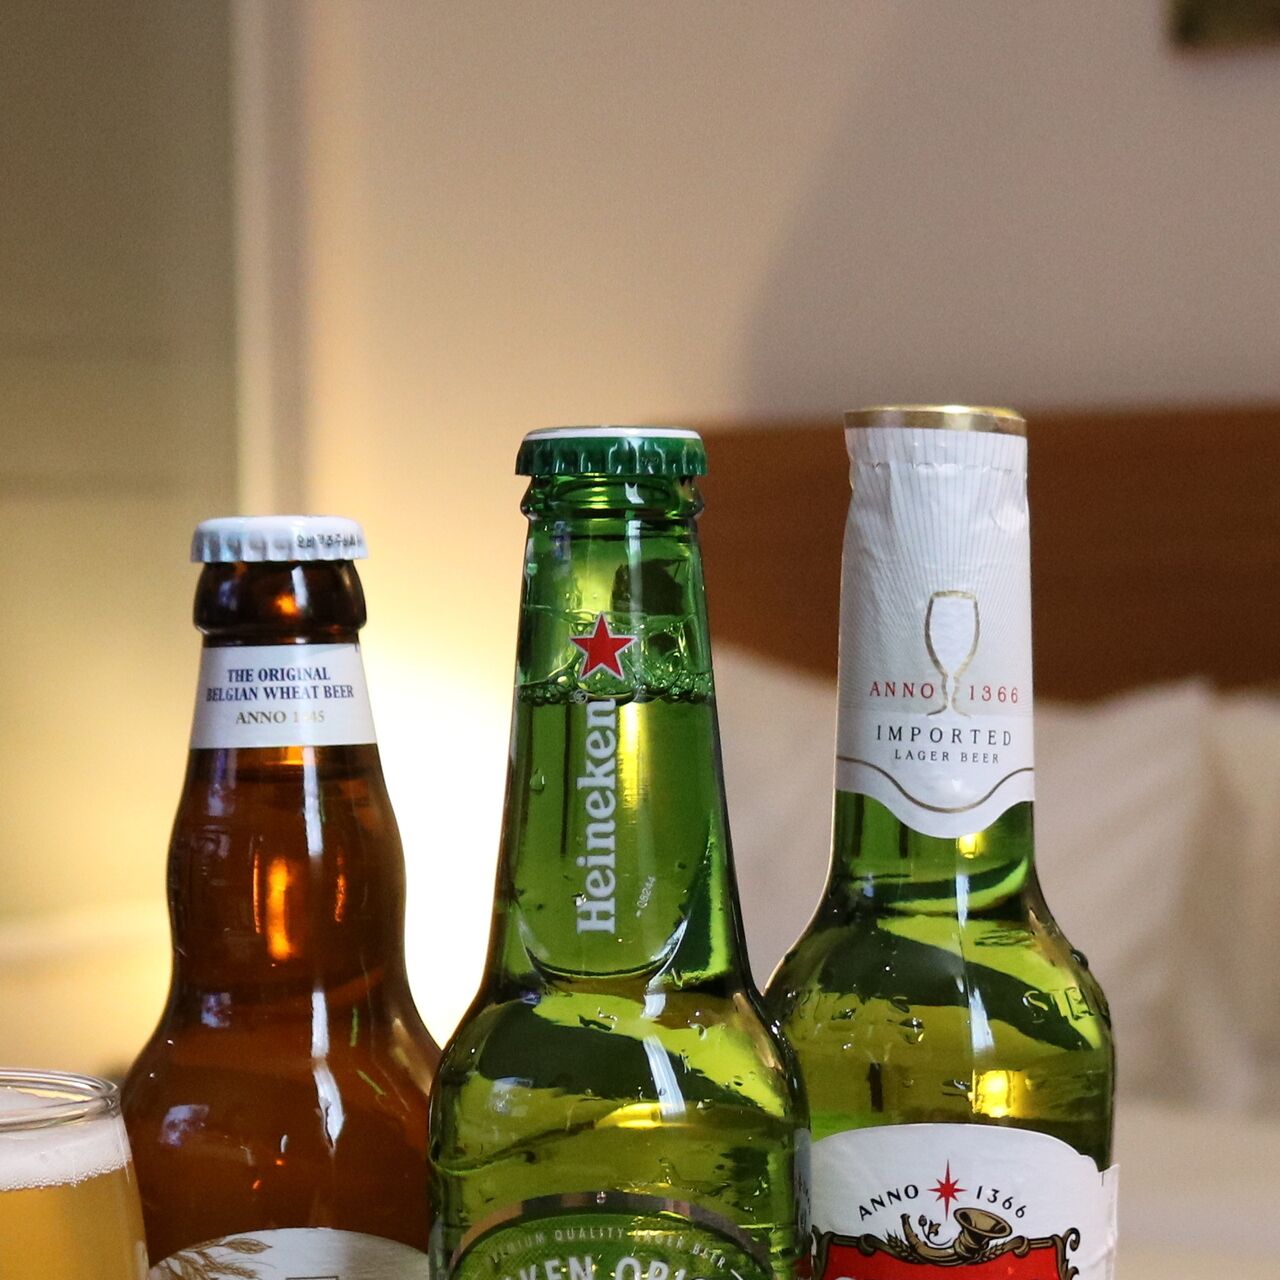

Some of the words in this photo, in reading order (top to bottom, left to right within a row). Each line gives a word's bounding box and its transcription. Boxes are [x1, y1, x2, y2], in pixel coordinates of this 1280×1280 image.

[228, 668, 253, 682] THE
[258, 667, 330, 682] ORIGINAL
[206, 687, 257, 702] BELGIAN
[264, 686, 319, 700] WHEAT
[323, 684, 354, 699] BEER
[869, 681, 935, 700] ANNO
[969, 685, 1019, 704] 1366
[236, 710, 286, 725] ANNO
[293, 710, 325, 724] 145
[876, 724, 1013, 748] IMPORTED
[894, 749, 950, 763] LAGER
[960, 751, 999, 765] BEER
[576, 698, 618, 936] Heineken
[858, 1184, 919, 1221] ANNO
[976, 1185, 1026, 1219] 1366
[554, 1226, 625, 1241] QUALITY
